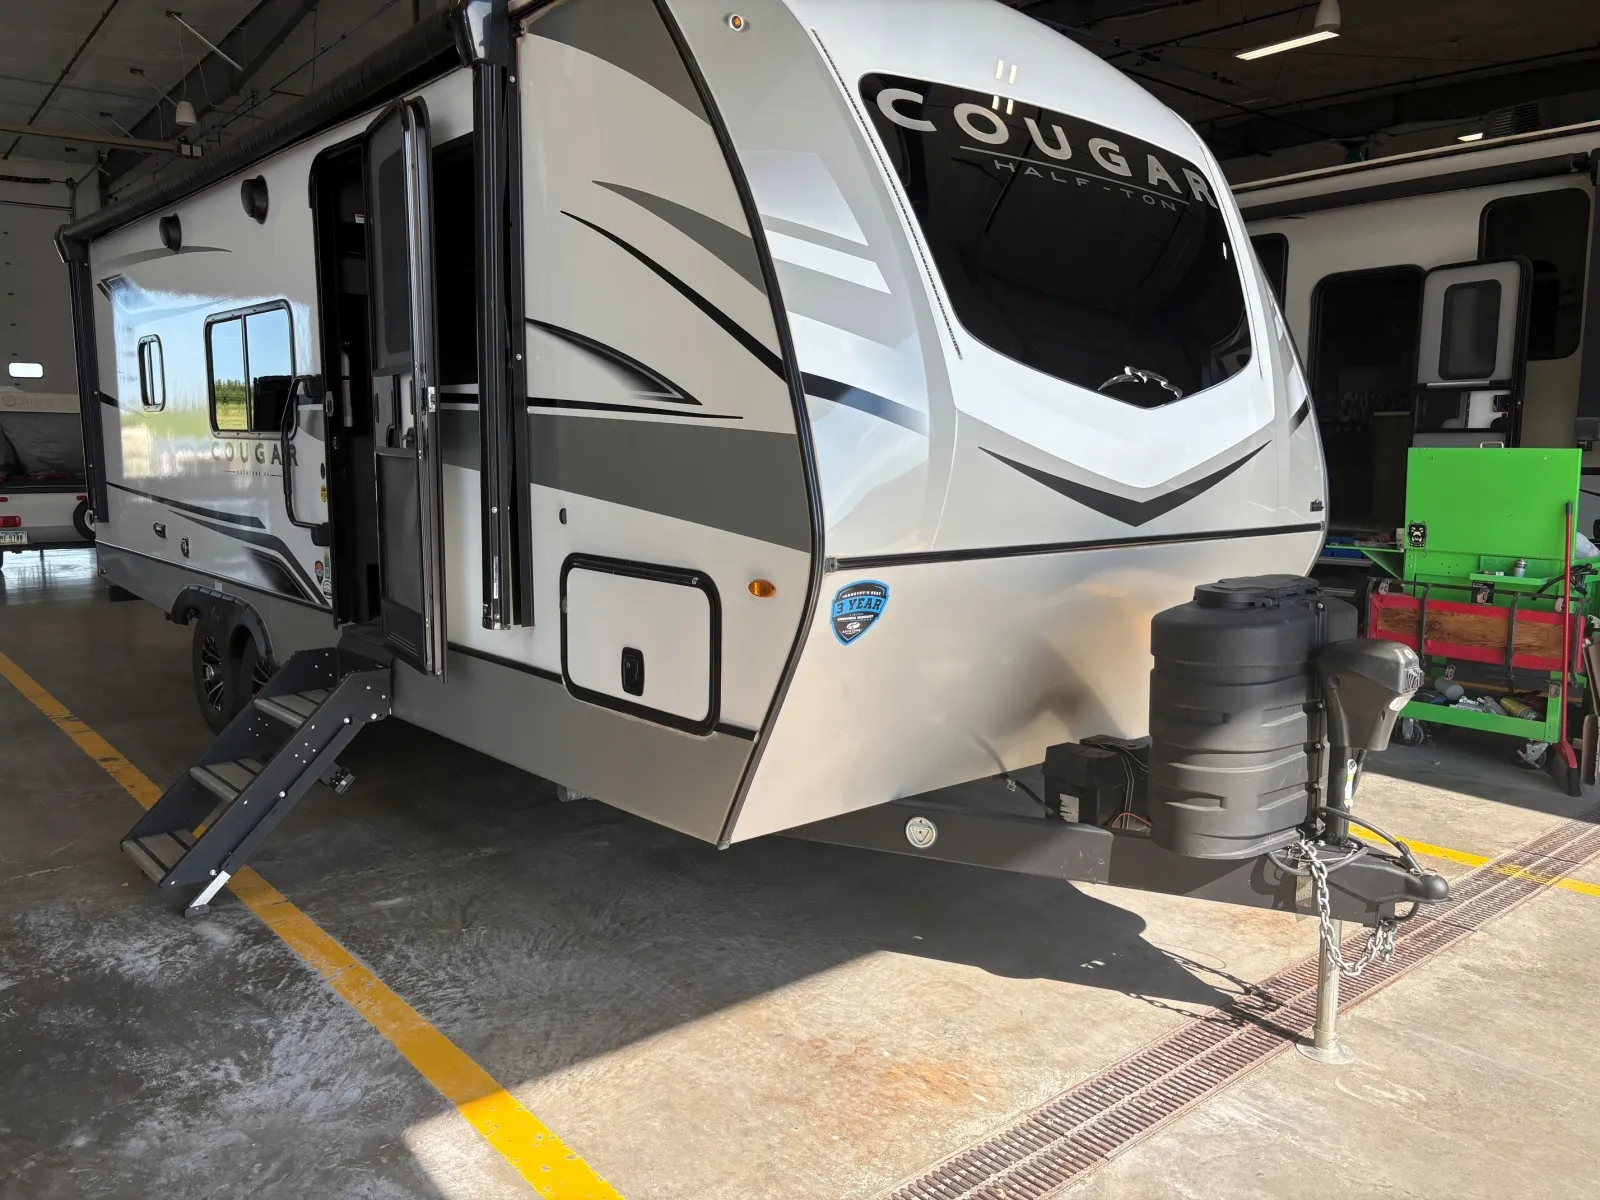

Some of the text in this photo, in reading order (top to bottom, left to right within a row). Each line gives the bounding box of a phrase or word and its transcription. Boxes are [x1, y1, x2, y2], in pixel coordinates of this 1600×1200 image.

[877, 88, 1219, 210] COUGAR
[994, 159, 1176, 211] HALF-TON
[212, 442, 298, 467] COUGAR
[836, 597, 882, 614] 3 YEAR
